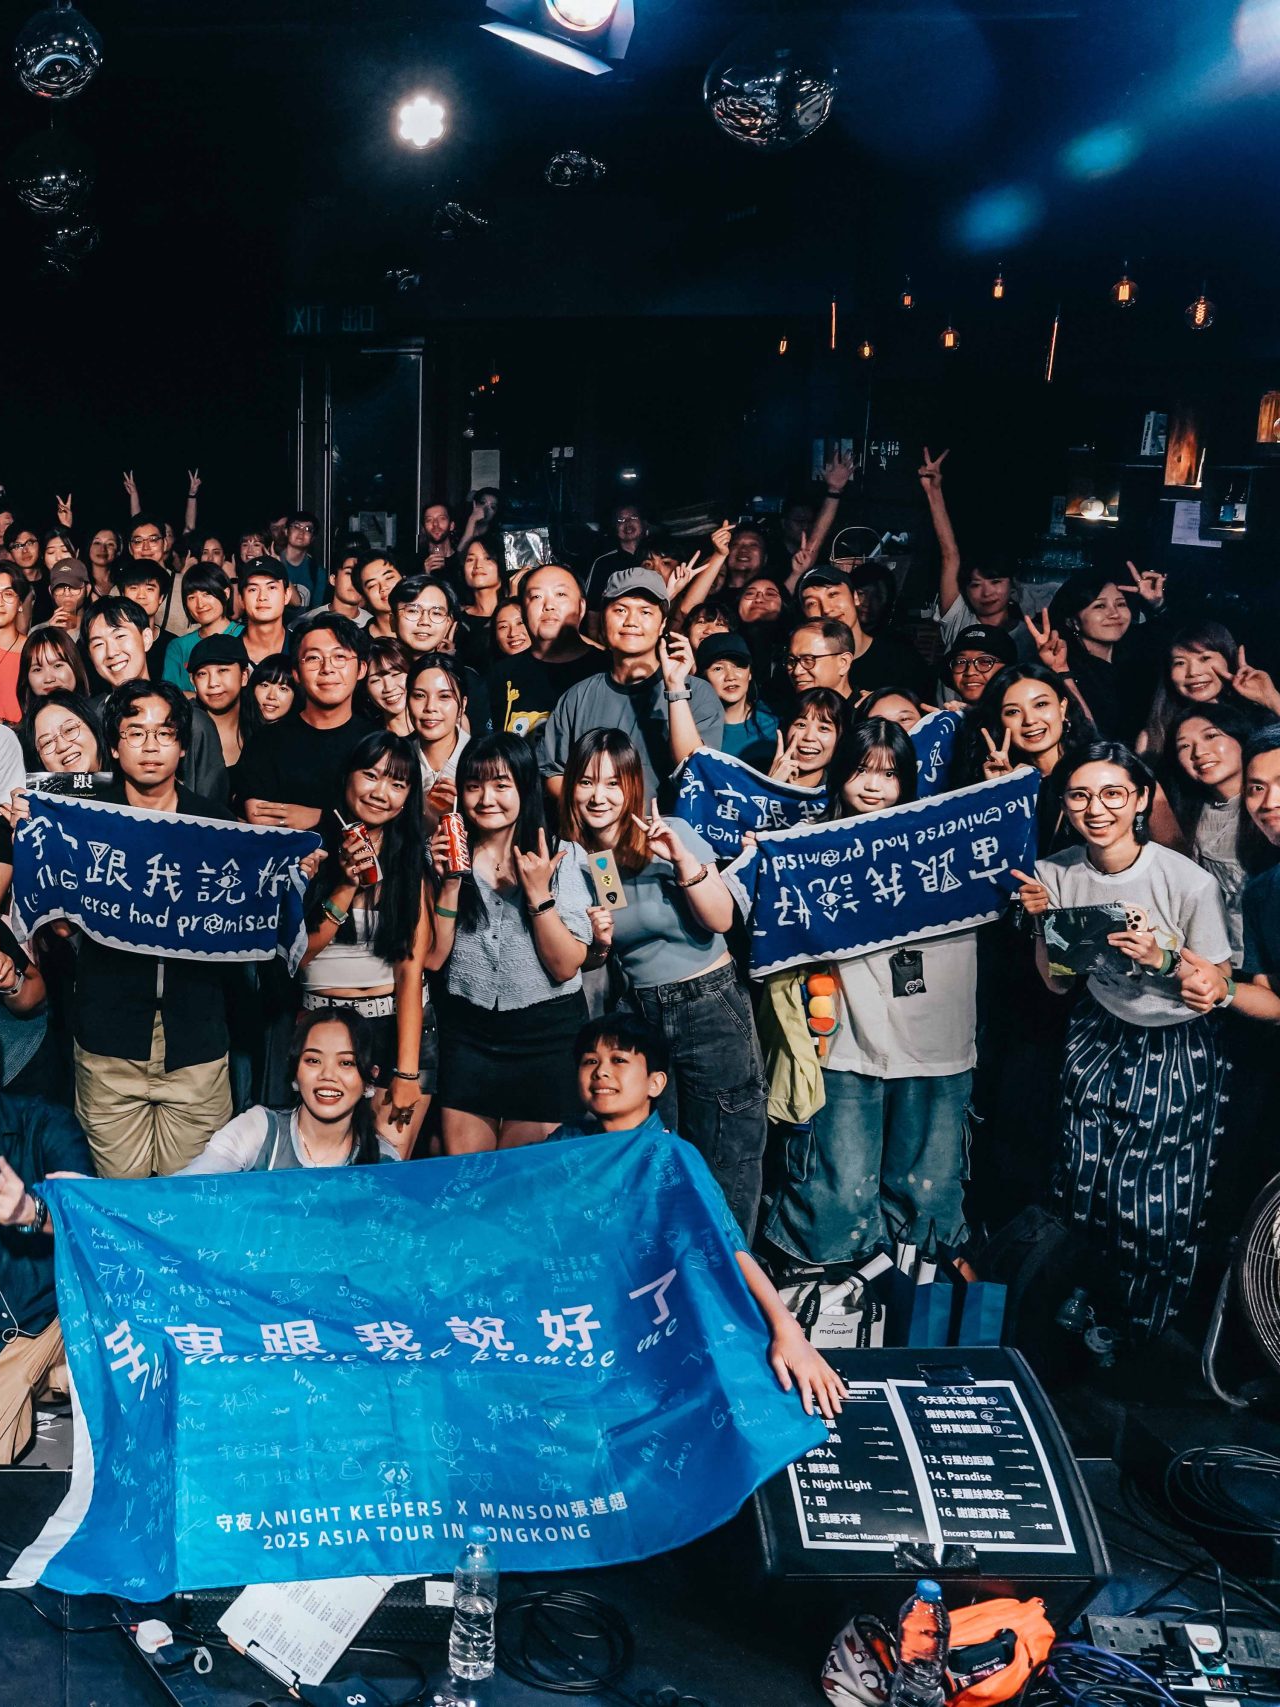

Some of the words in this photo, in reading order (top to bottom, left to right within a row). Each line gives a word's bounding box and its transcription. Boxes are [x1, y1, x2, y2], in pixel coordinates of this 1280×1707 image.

[872, 833, 909, 853] had
[130, 902, 170, 932] had
[819, 1327, 854, 1336] mofusand
[381, 1342, 452, 1362] had
[470, 1347, 616, 1369] promise
[637, 1317, 679, 1353] me
[923, 1454, 941, 1464] 13.
[796, 1463, 807, 1473] 5.
[928, 1471, 946, 1481] 14.
[946, 1471, 993, 1482] Paradise
[799, 1479, 811, 1489] 6.
[812, 1479, 843, 1492] Night
[845, 1479, 873, 1492] Light
[933, 1488, 951, 1499] 15.
[802, 1495, 815, 1506] 7.
[815, 1495, 828, 1507] 田
[215, 1506, 341, 1533] 守夜人NIGHT
[349, 1500, 443, 1521] KEEPERS
[456, 1499, 468, 1515] X
[480, 1491, 628, 1520] MANSON張進翹
[806, 1512, 818, 1523] 8.
[938, 1507, 956, 1518] 16.
[263, 1532, 310, 1550] 2025
[317, 1526, 370, 1547] ASIA
[376, 1522, 440, 1544] TOUR
[443, 1523, 464, 1540] IN
[484, 1523, 591, 1543] ONGKONG
[942, 1529, 969, 1539] Encore
[436, 1589, 450, 1602] 2
